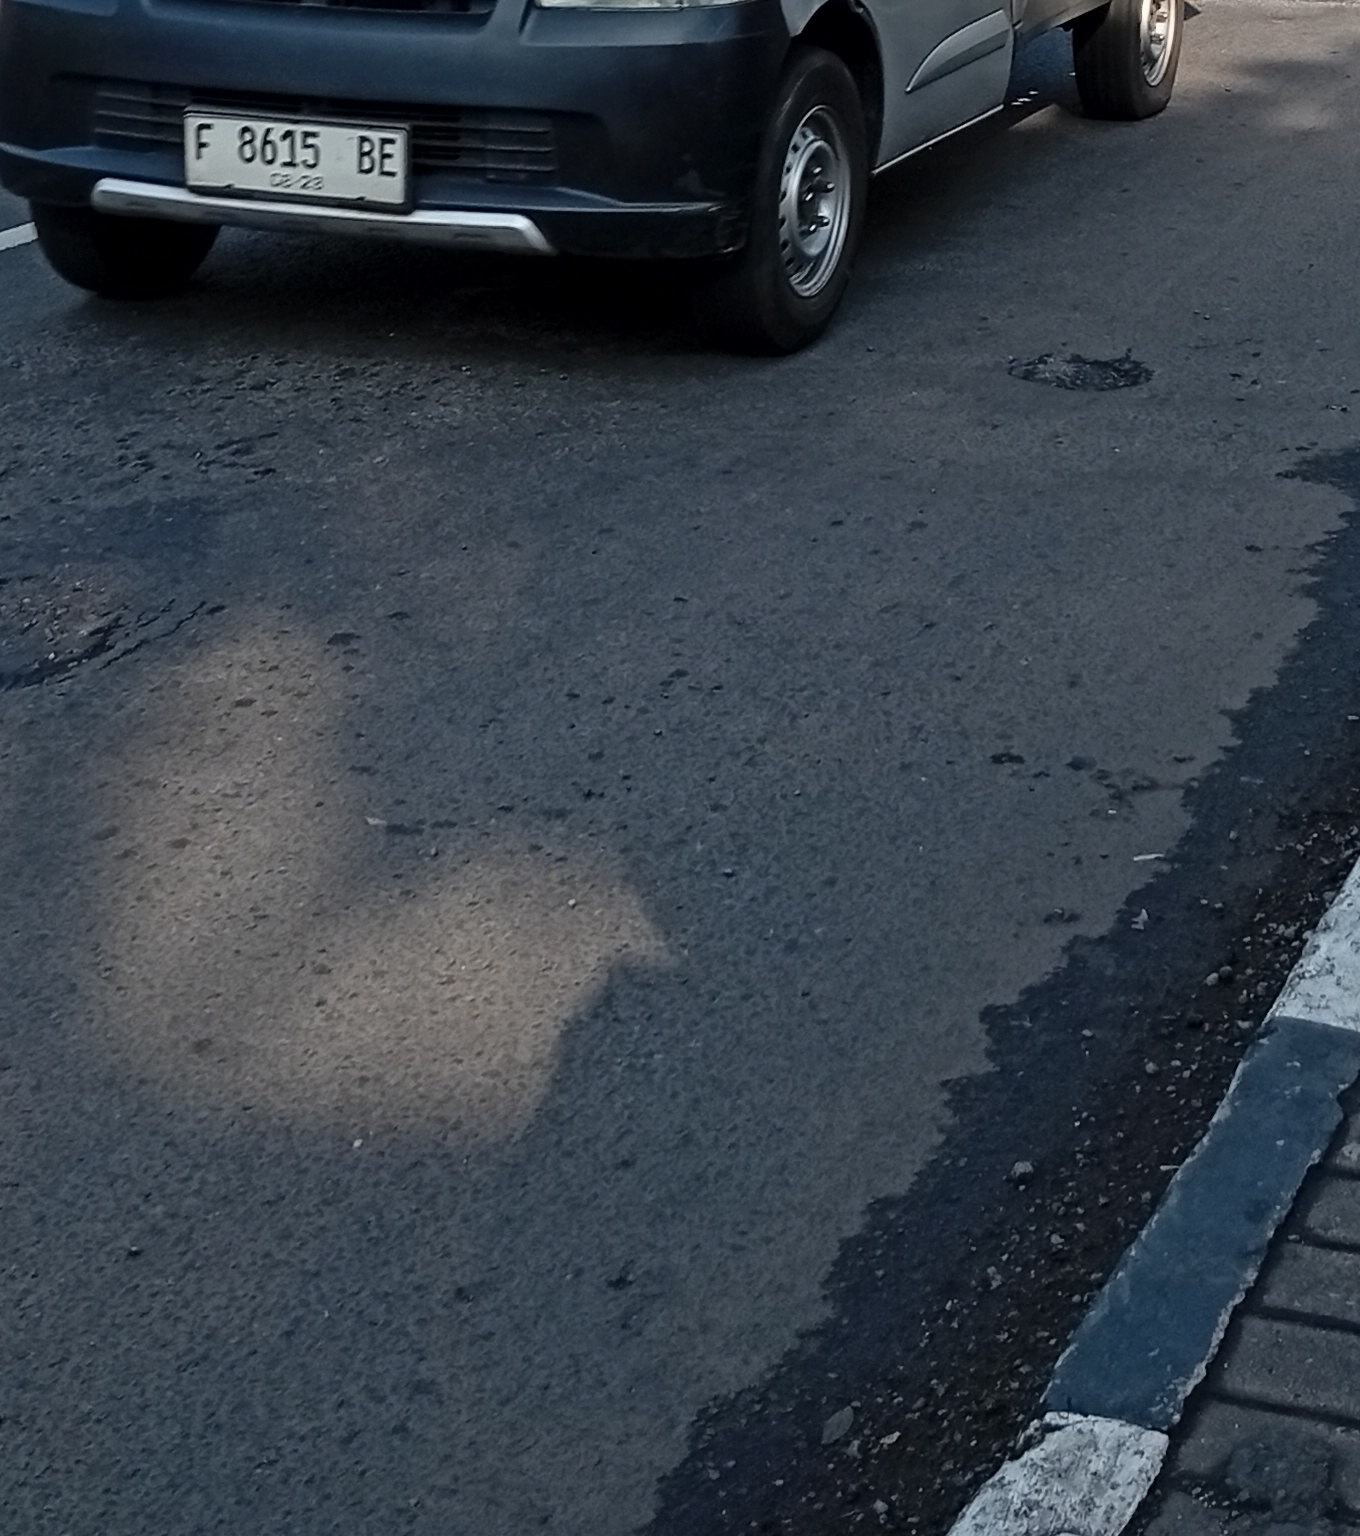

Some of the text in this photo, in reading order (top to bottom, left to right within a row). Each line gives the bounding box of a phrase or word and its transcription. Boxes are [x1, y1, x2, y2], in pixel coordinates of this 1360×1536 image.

[196, 123, 398, 177] F 8615 BE
